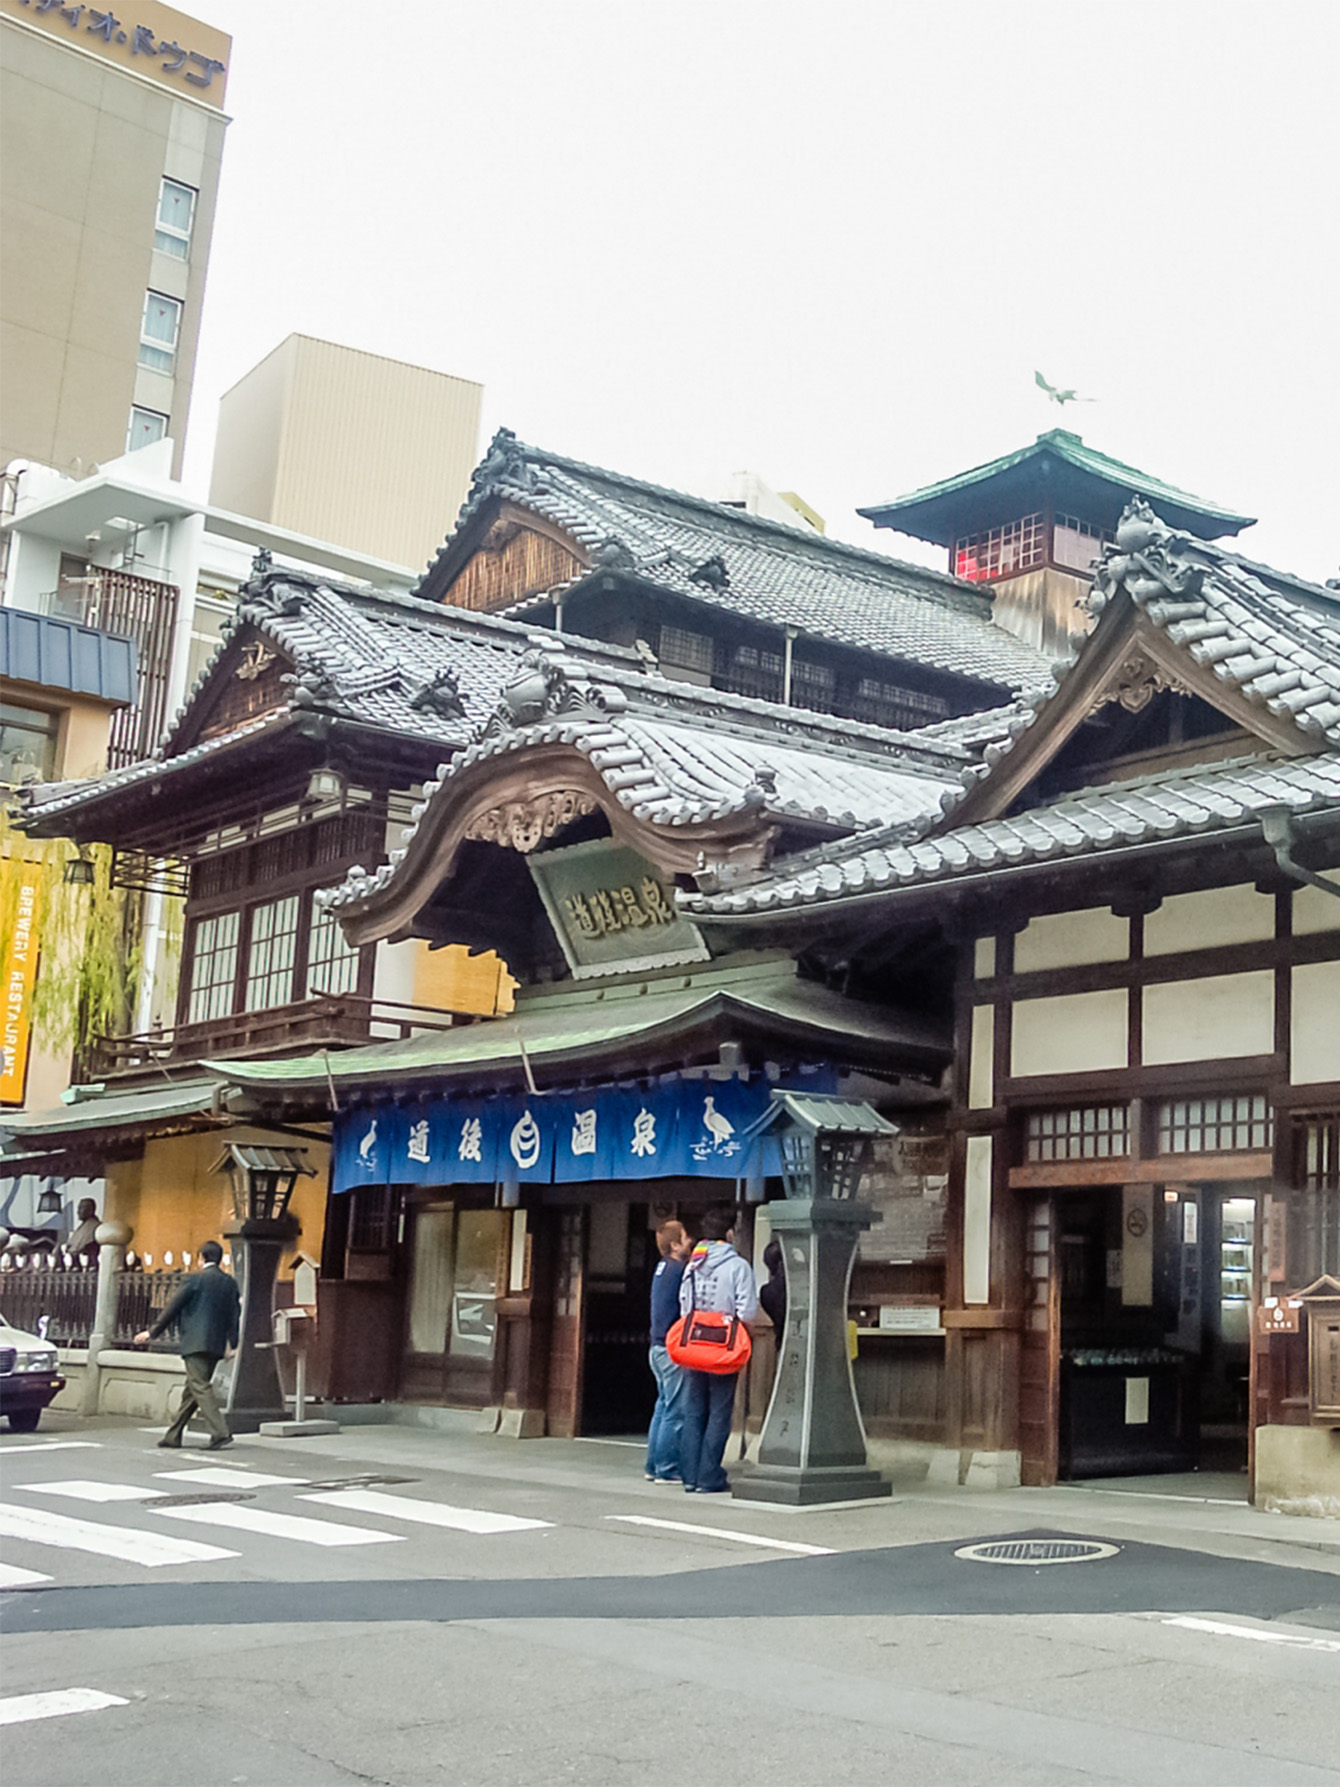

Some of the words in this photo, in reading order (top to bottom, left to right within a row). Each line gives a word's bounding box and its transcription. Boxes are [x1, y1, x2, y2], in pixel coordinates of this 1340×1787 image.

[13, 885, 34, 963] BREWERY
[2, 971, 25, 1078] RESTAURANT
[406, 1117, 483, 1164] 道後
[571, 1107, 657, 1156] 温泉
